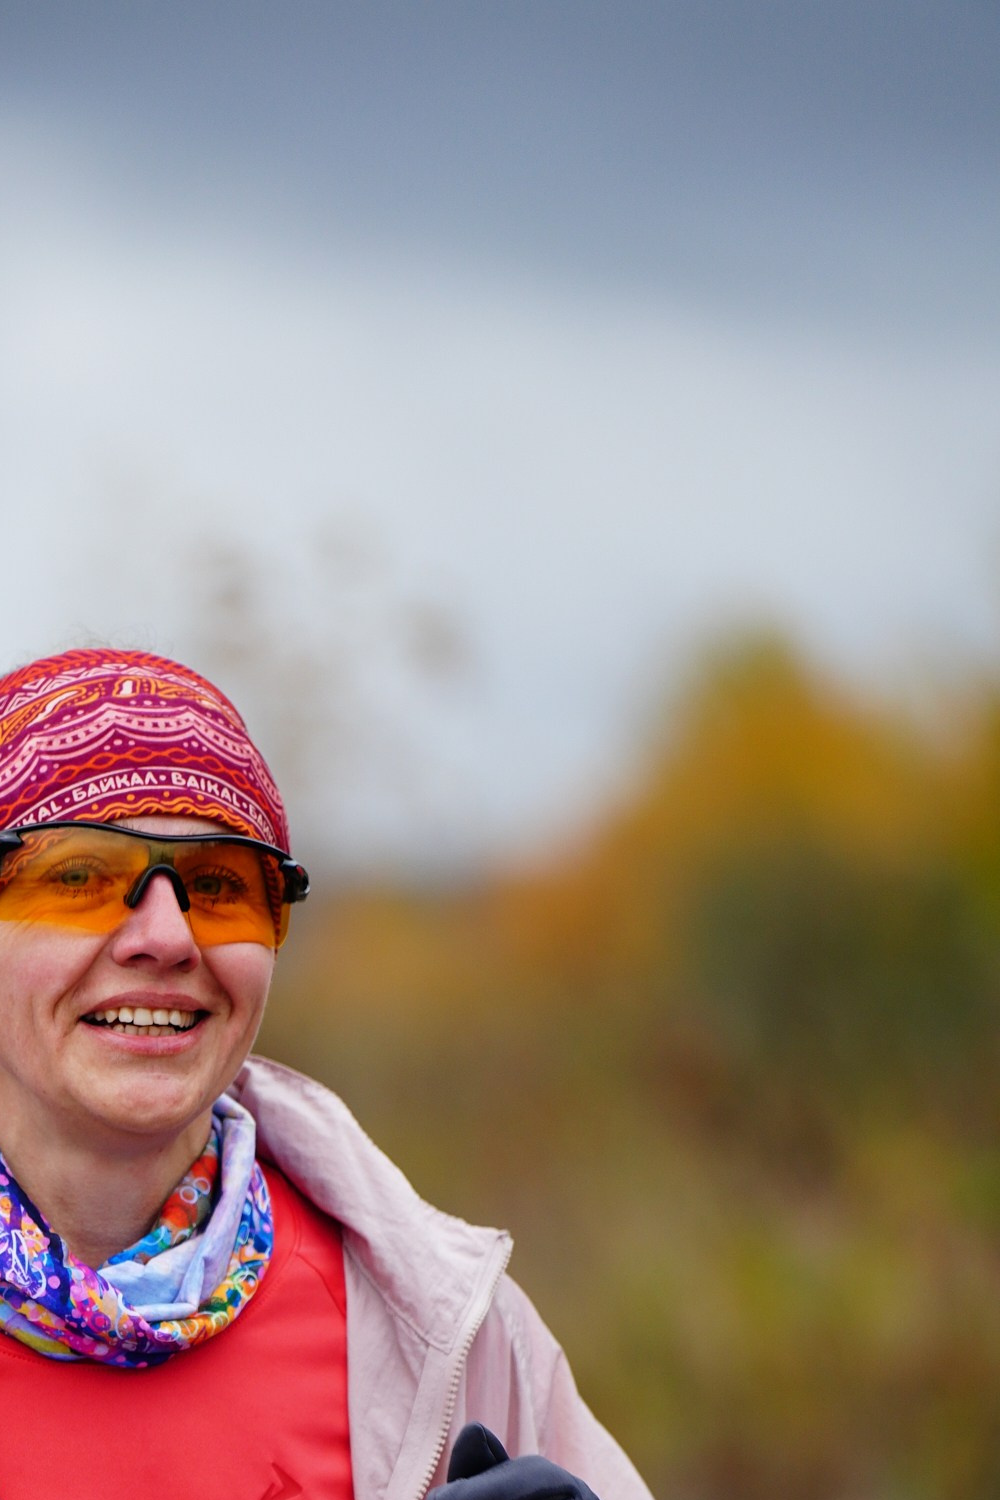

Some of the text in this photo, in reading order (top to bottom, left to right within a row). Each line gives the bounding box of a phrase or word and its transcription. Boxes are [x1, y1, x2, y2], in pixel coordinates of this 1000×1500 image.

[72, 771, 158, 802] БАЙКАЛ
[171, 771, 241, 808] BAIKAL
[17, 800, 62, 826] KAL
